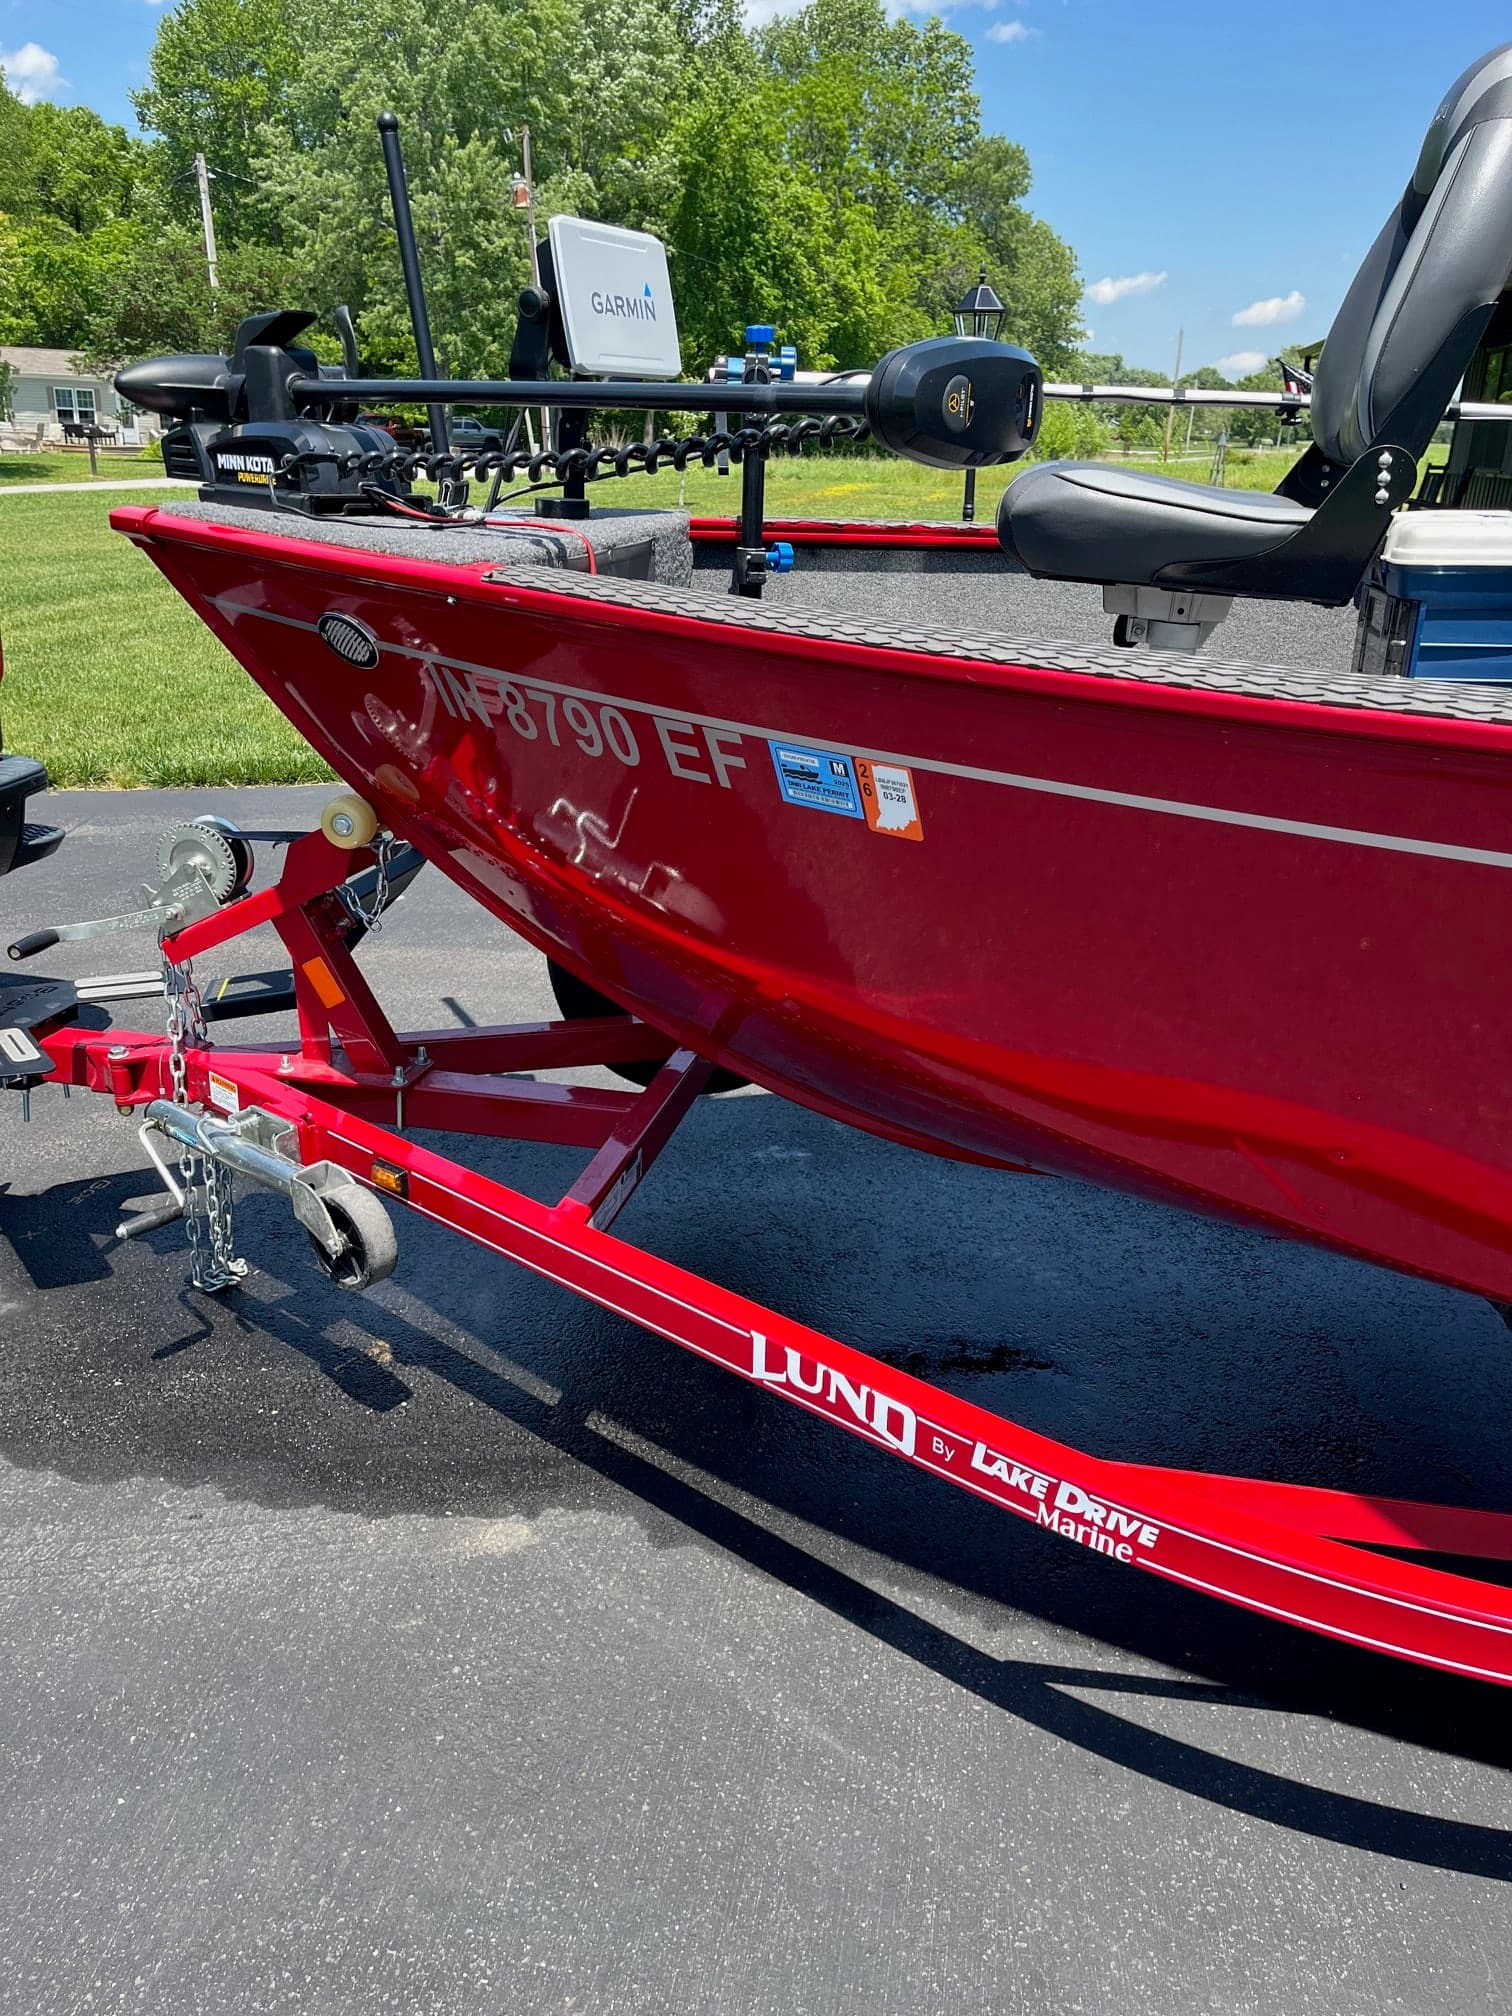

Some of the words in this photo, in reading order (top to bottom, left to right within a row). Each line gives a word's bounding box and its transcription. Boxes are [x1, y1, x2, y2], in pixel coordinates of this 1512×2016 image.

[591, 291, 656, 321] GARMIN
[217, 453, 245, 470] MINN
[245, 456, 274, 473] KOTA
[238, 472, 277, 485] POWERDRIE
[428, 661, 494, 728] IN
[497, 680, 641, 767] 8790
[653, 715, 747, 790] EF
[832, 762, 846, 776] M
[749, 1329, 918, 1457] LUND
[931, 1436, 955, 1461] By
[970, 1441, 1050, 1500] LAKE
[1054, 1480, 1160, 1549] DRIVE
[1035, 1501, 1133, 1564] Marine
